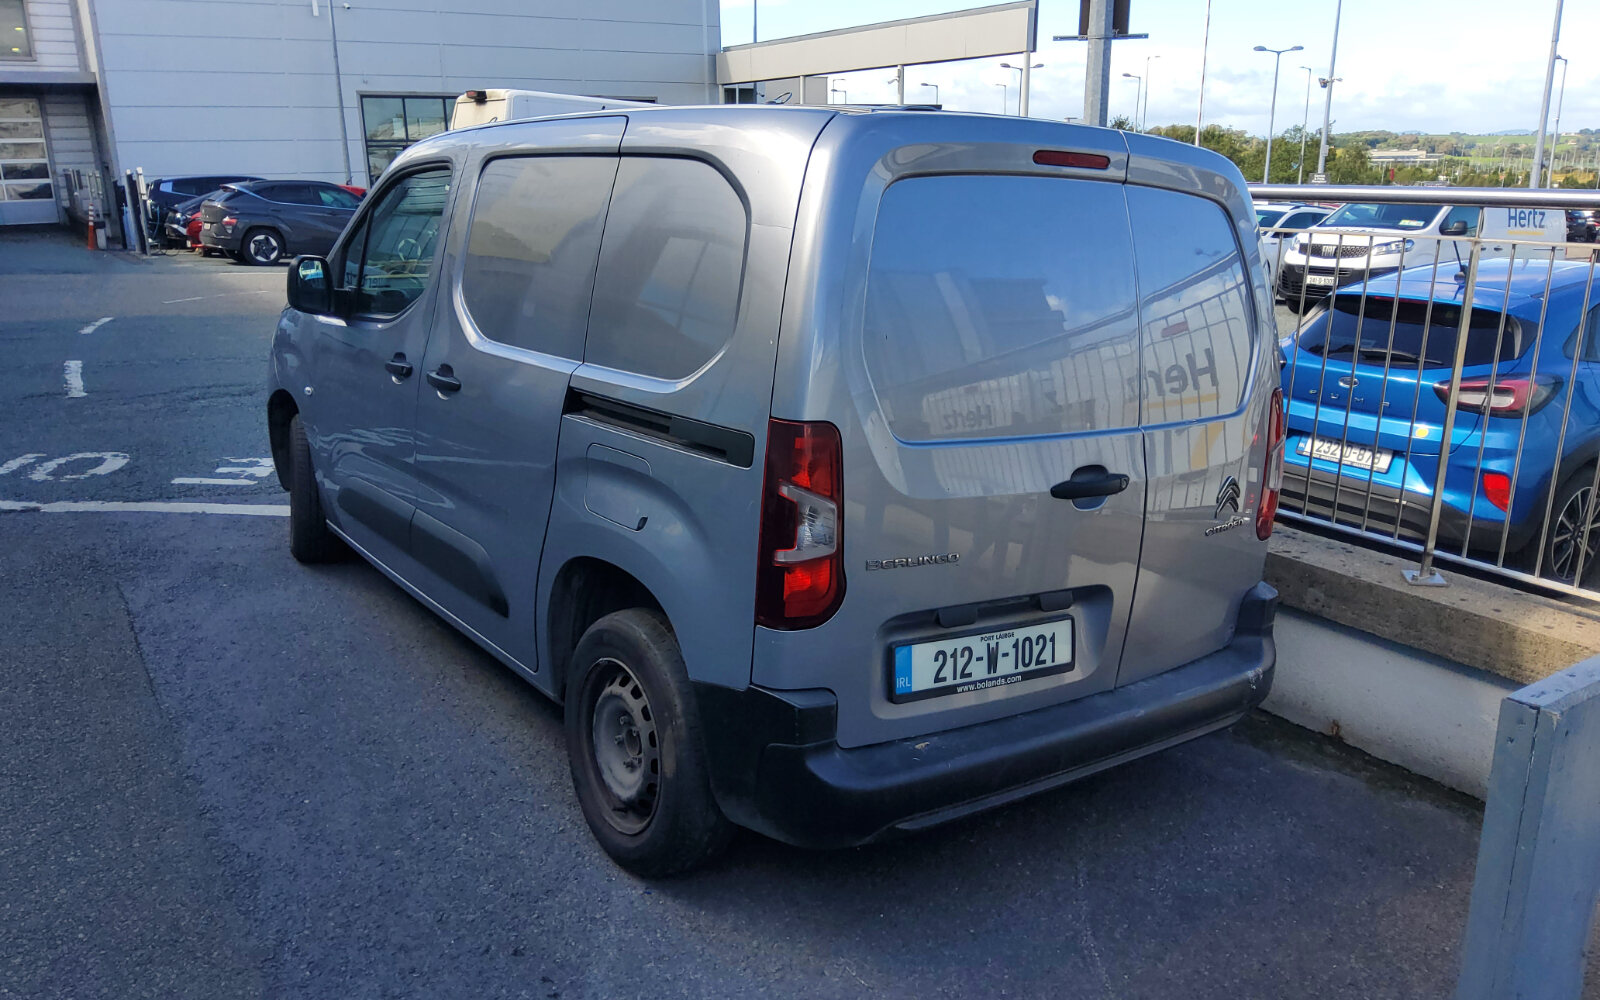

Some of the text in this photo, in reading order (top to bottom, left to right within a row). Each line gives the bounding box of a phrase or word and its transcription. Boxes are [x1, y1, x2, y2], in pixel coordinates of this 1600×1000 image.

[1507, 207, 1545, 229] Hertz
[865, 552, 960, 571] BERLINGO
[933, 632, 1056, 684] 212-W-1021
[896, 677, 911, 689] IRL
[956, 674, 1022, 693] www.bolands.com
